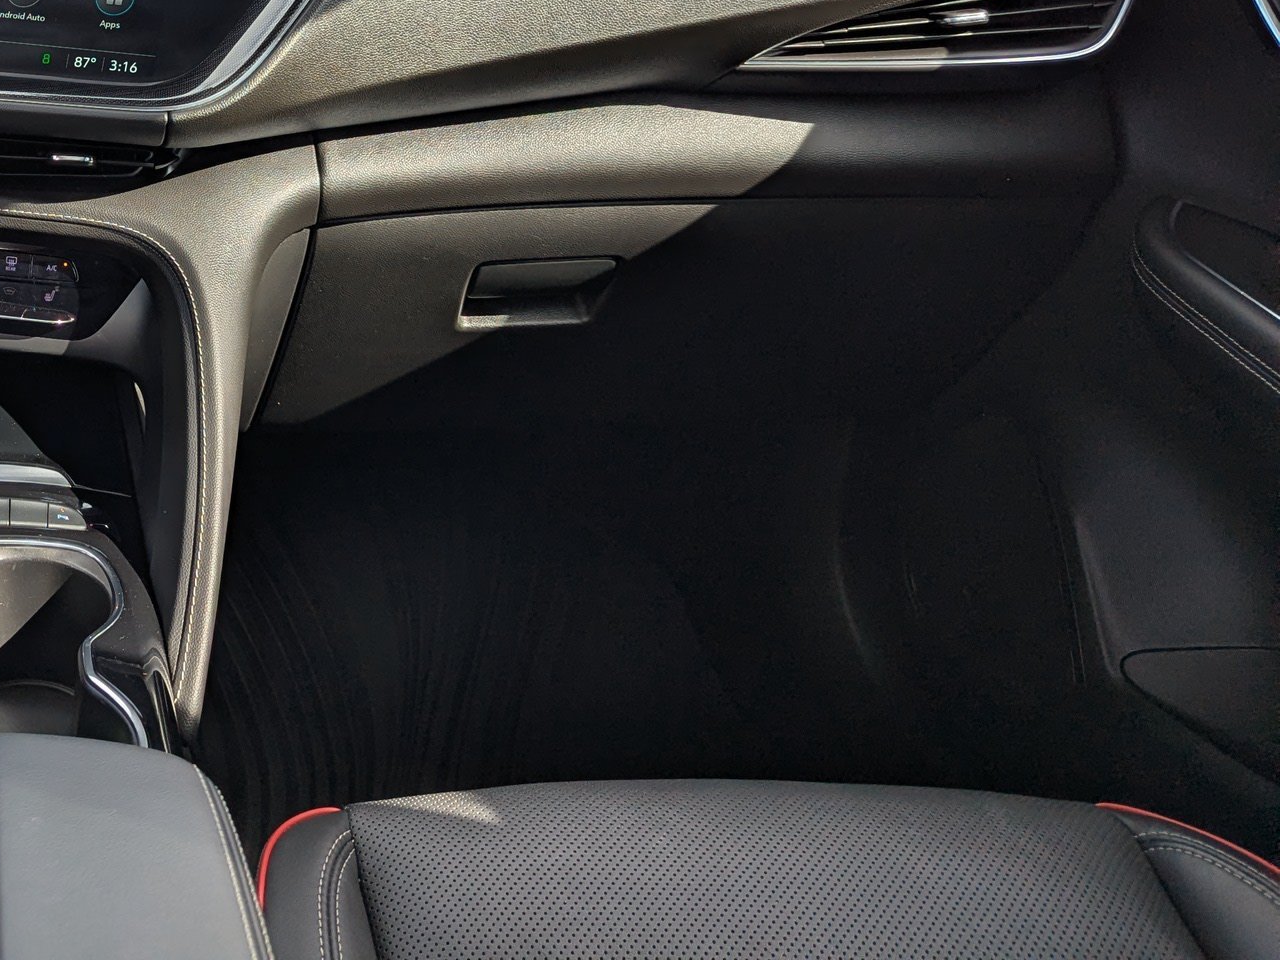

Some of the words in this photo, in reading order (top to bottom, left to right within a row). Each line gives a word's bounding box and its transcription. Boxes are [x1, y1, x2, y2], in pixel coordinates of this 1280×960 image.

[26, 13, 46, 22] Auto
[99, 20, 121, 30] Apps
[73, 56, 97, 68] 87°
[108, 59, 138, 74] 3:16
[46, 264, 57, 272] A/C
